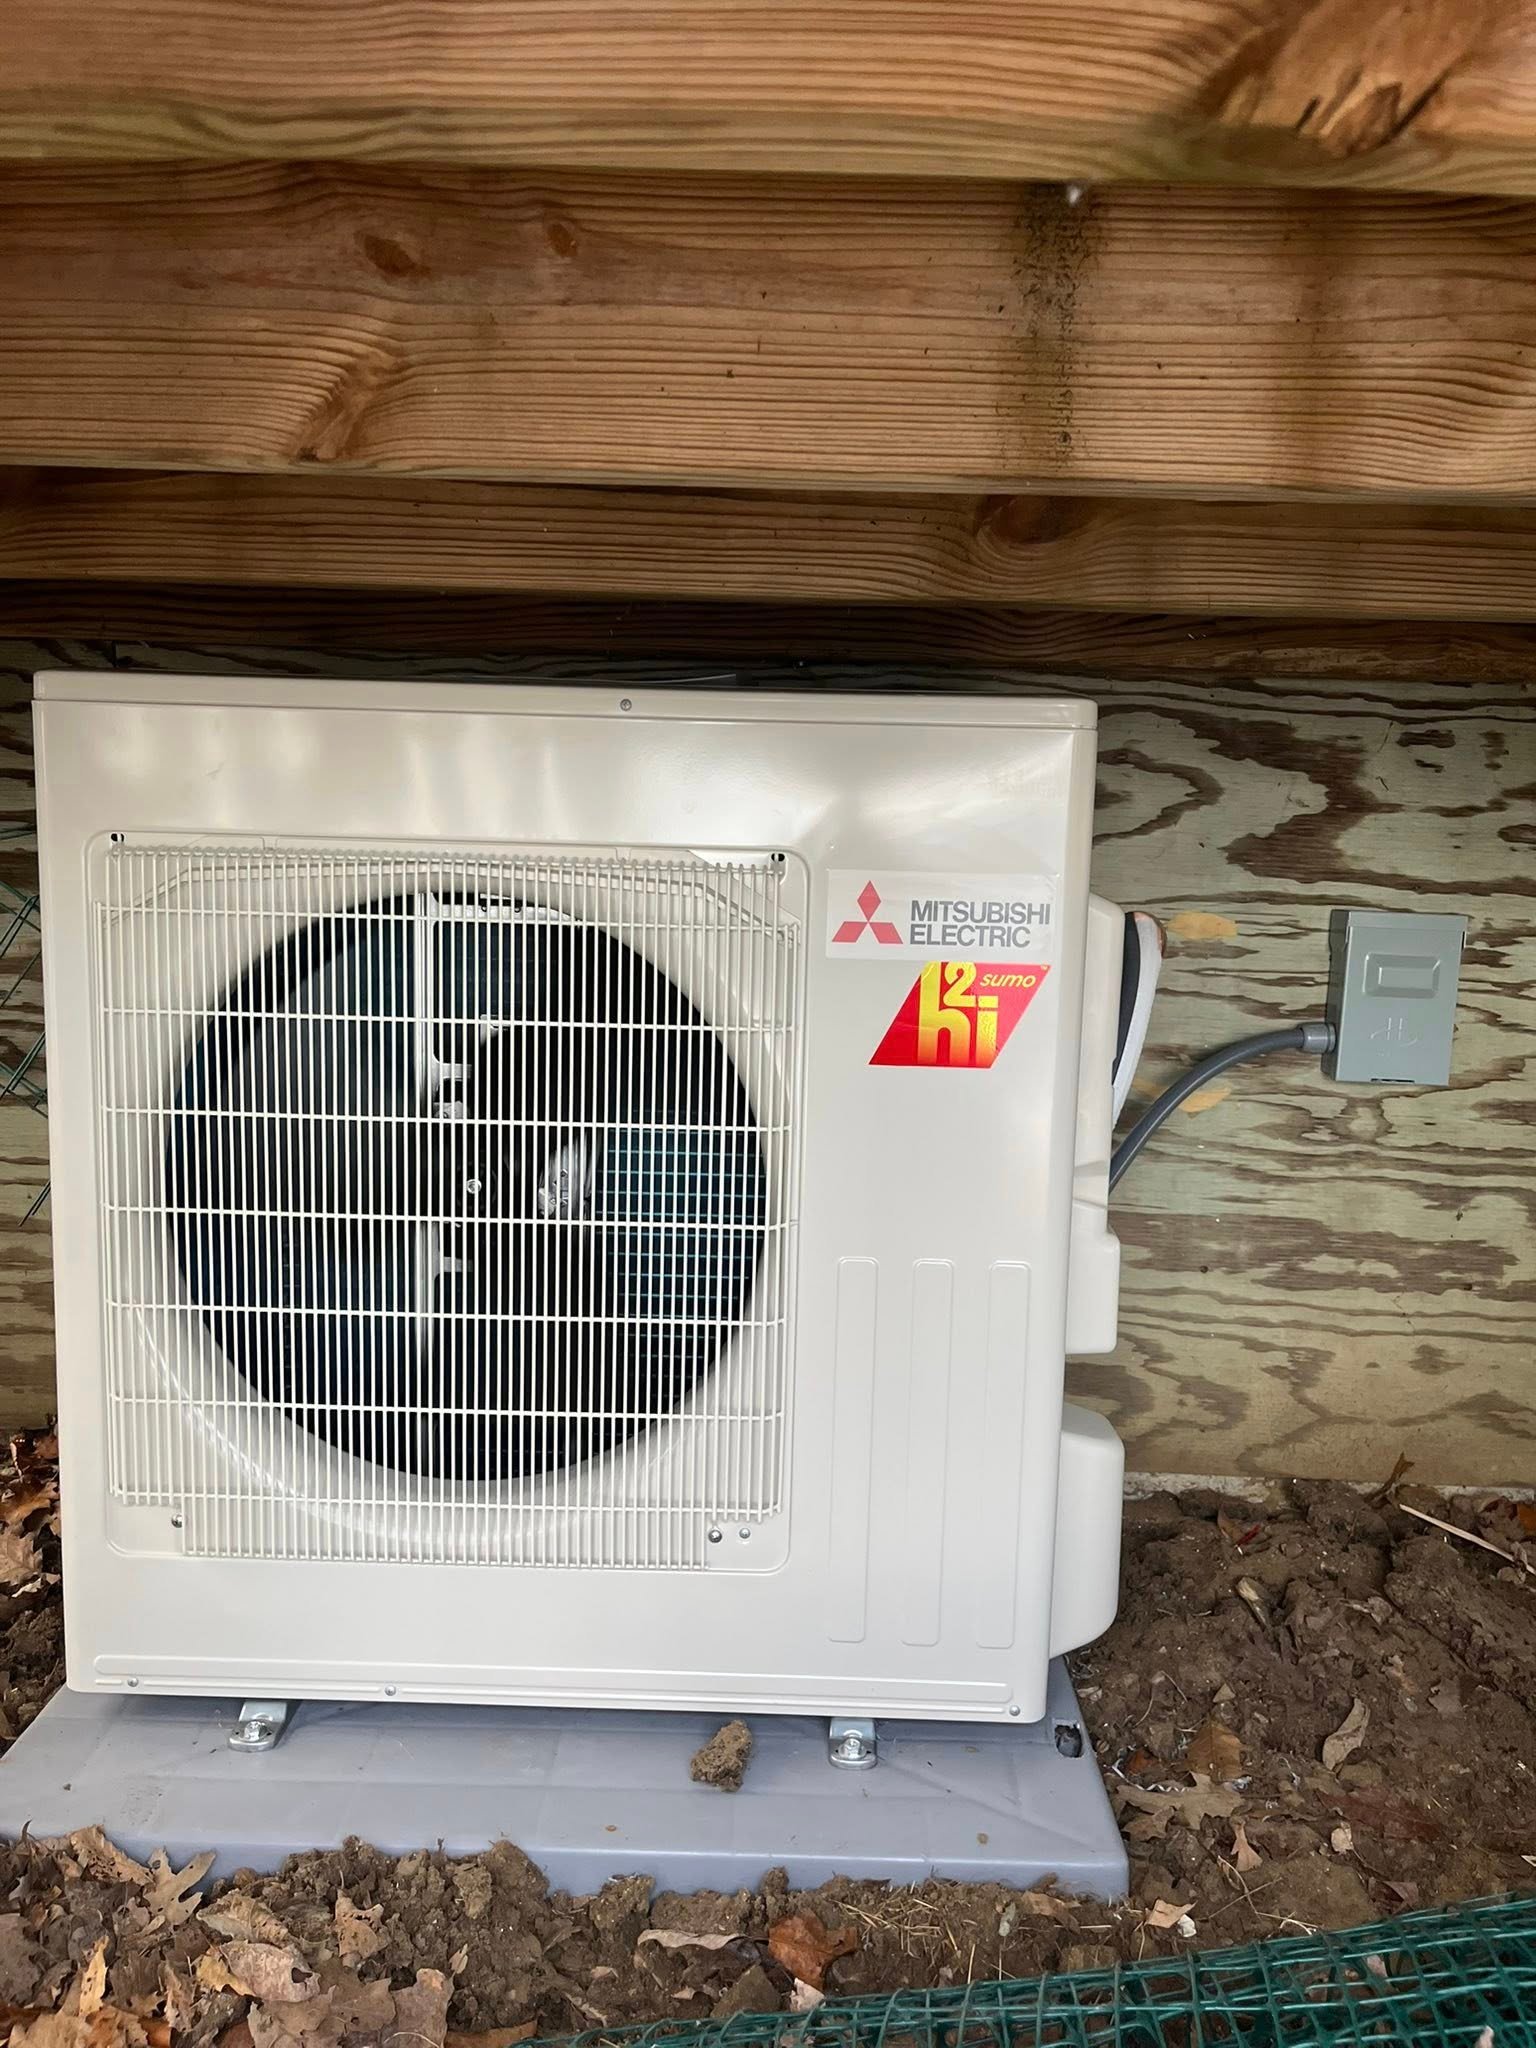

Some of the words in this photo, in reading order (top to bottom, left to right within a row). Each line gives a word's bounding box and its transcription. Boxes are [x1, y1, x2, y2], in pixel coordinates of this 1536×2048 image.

[911, 900, 1051, 925] MITSUBISHI
[909, 924, 1031, 948] ELECTRIC
[979, 972, 1037, 988] sumo
